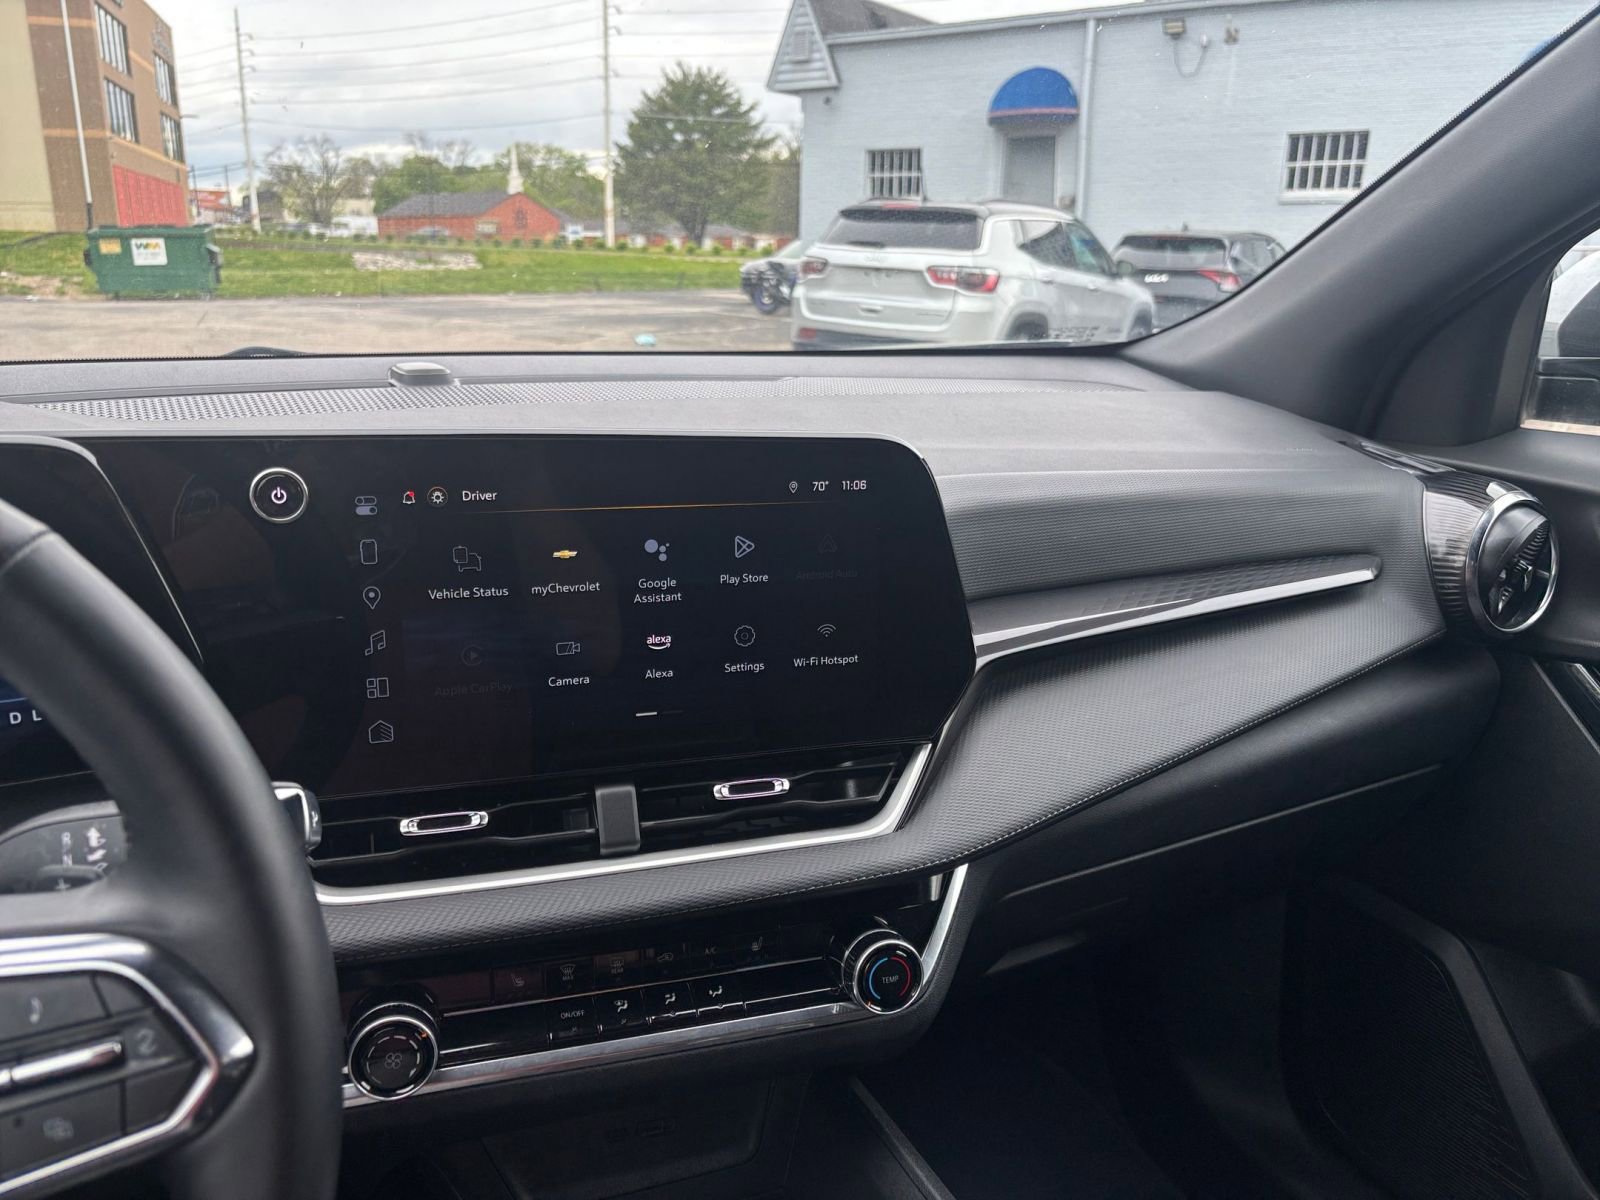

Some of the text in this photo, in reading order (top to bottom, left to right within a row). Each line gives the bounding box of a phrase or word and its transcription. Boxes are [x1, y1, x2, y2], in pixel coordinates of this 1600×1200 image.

[812, 480, 867, 492] 70° 11:06
[462, 490, 497, 501] Driver
[638, 577, 677, 590] Google
[720, 573, 769, 586] Play Store
[428, 586, 509, 600] Vehicle Status
[531, 581, 600, 595] myChevrolet
[633, 592, 682, 604] Assistant
[646, 635, 672, 645] alexa
[724, 661, 765, 673] Settings
[793, 654, 859, 668] Wi-Fi Hotspot
[645, 668, 673, 679] Alexa
[548, 675, 590, 687] Camera
[435, 680, 513, 698] Apple CarPlay
[9, 709, 42, 724] D L
[881, 974, 899, 985] TEMP
[560, 1009, 585, 1020] ON/OFF
